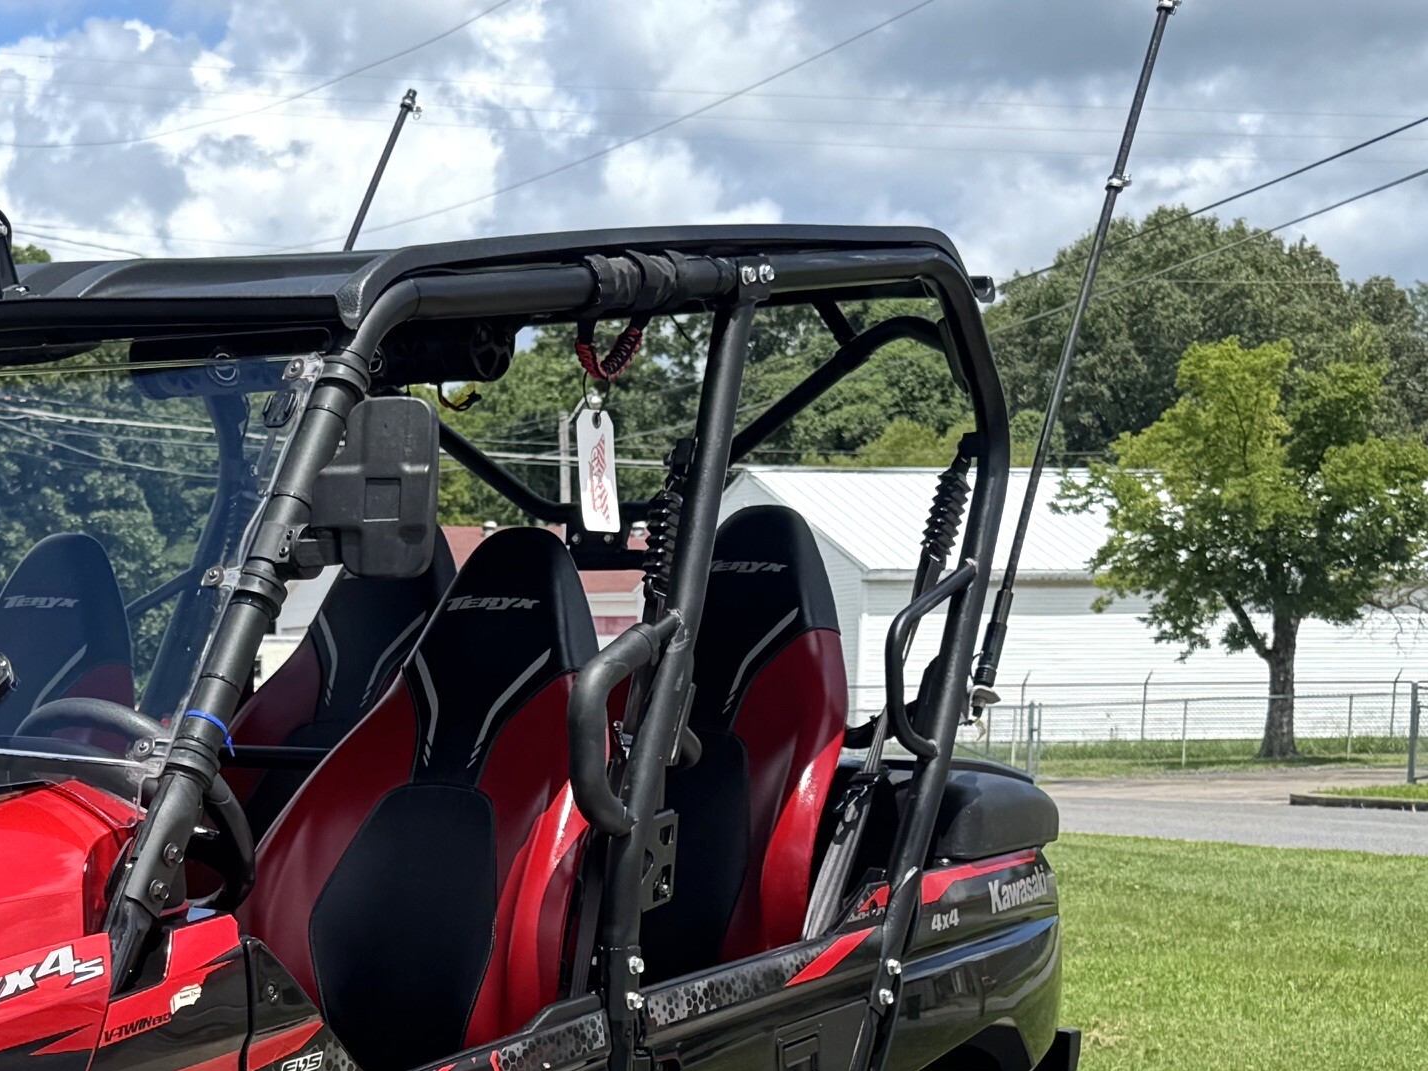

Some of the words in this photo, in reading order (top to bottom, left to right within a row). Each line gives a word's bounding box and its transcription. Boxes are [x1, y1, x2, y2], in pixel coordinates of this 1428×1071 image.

[711, 560, 788, 573] ERYX
[988, 864, 1049, 914] Kawasaki
[931, 908, 960, 932] 4x4
